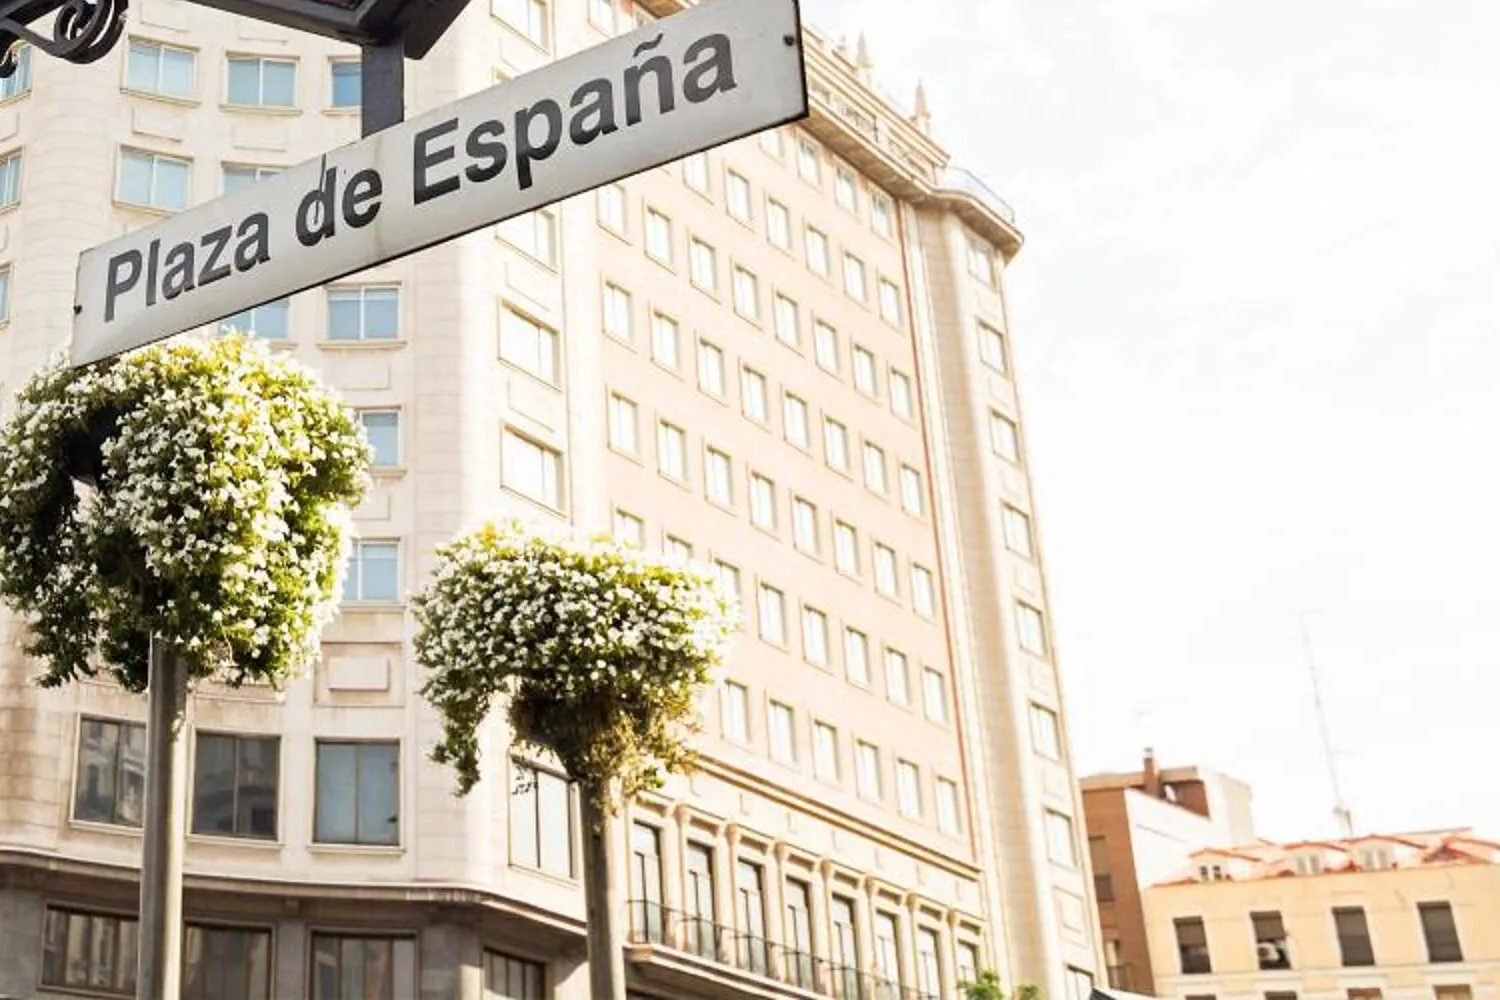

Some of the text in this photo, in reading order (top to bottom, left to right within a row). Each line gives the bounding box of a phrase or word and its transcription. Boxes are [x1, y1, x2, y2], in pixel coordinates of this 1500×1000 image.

[103, 32, 739, 323] Plaza de España
